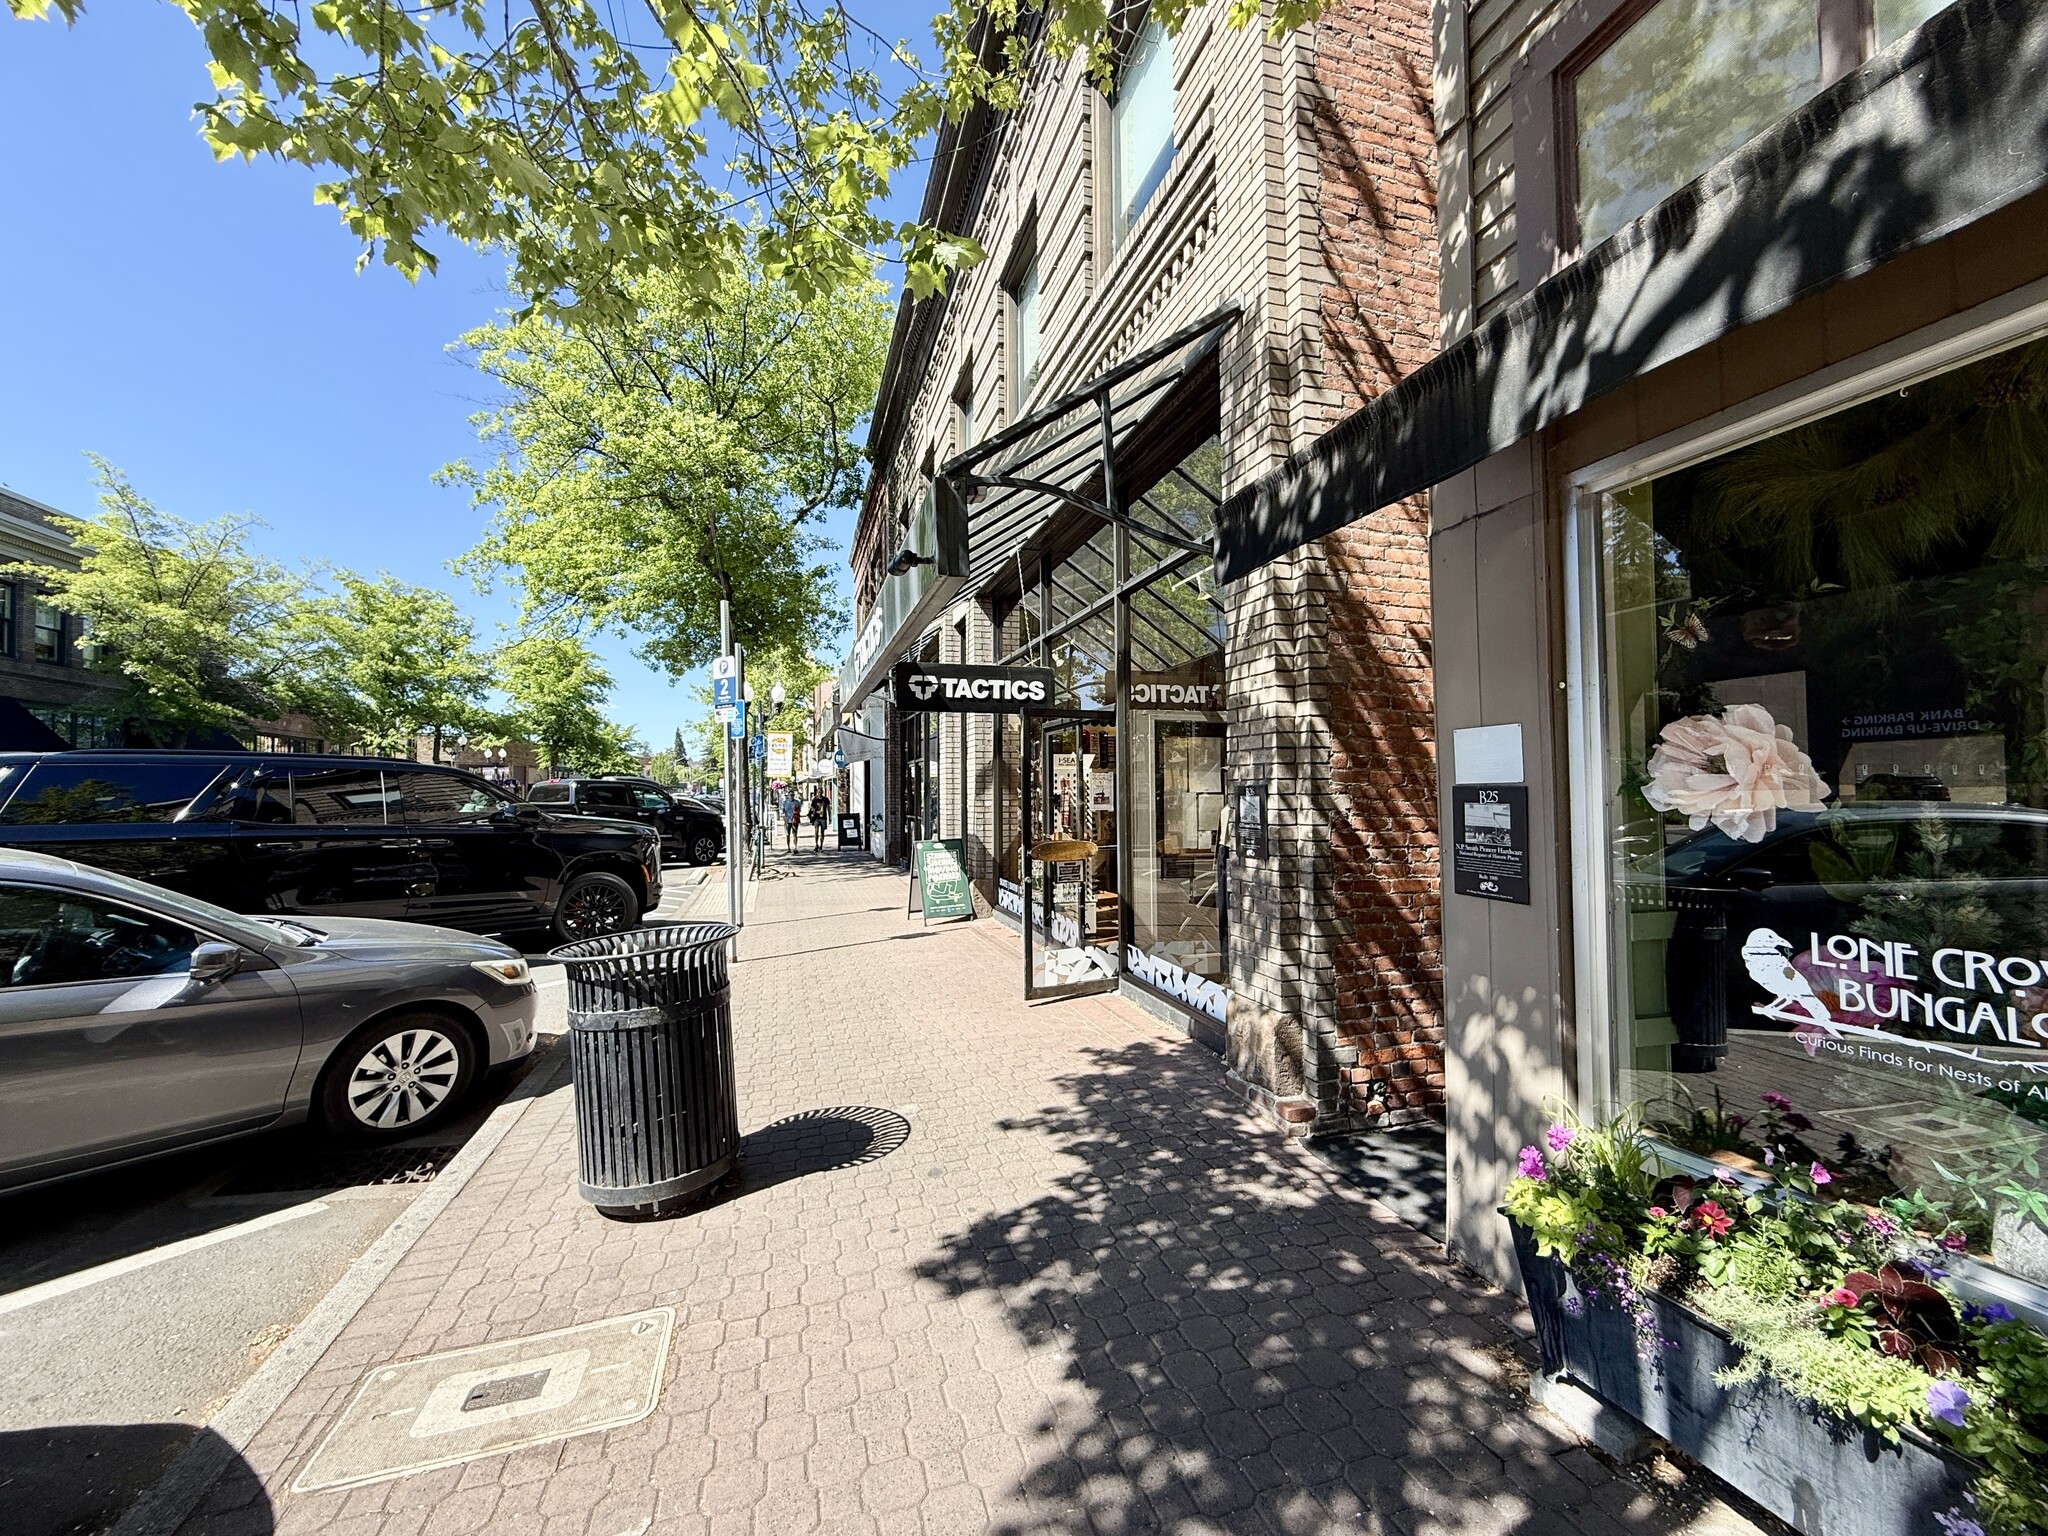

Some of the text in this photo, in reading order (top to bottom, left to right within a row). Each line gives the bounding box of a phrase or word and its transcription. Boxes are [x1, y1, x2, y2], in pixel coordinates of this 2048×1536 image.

[720, 678, 729, 696] 2
[941, 677, 1045, 701] TACTICS
[1479, 790, 1499, 805] B25
[1497, 847, 1523, 856] Hardware
[1811, 932, 2048, 997] LONE CRO
[1795, 1031, 1854, 1055] Curious
[1859, 1045, 1903, 1067] Finds
[1908, 1056, 1934, 1073] for
[1939, 1063, 1992, 1087] Nests
[1998, 1079, 2021, 1094] of
